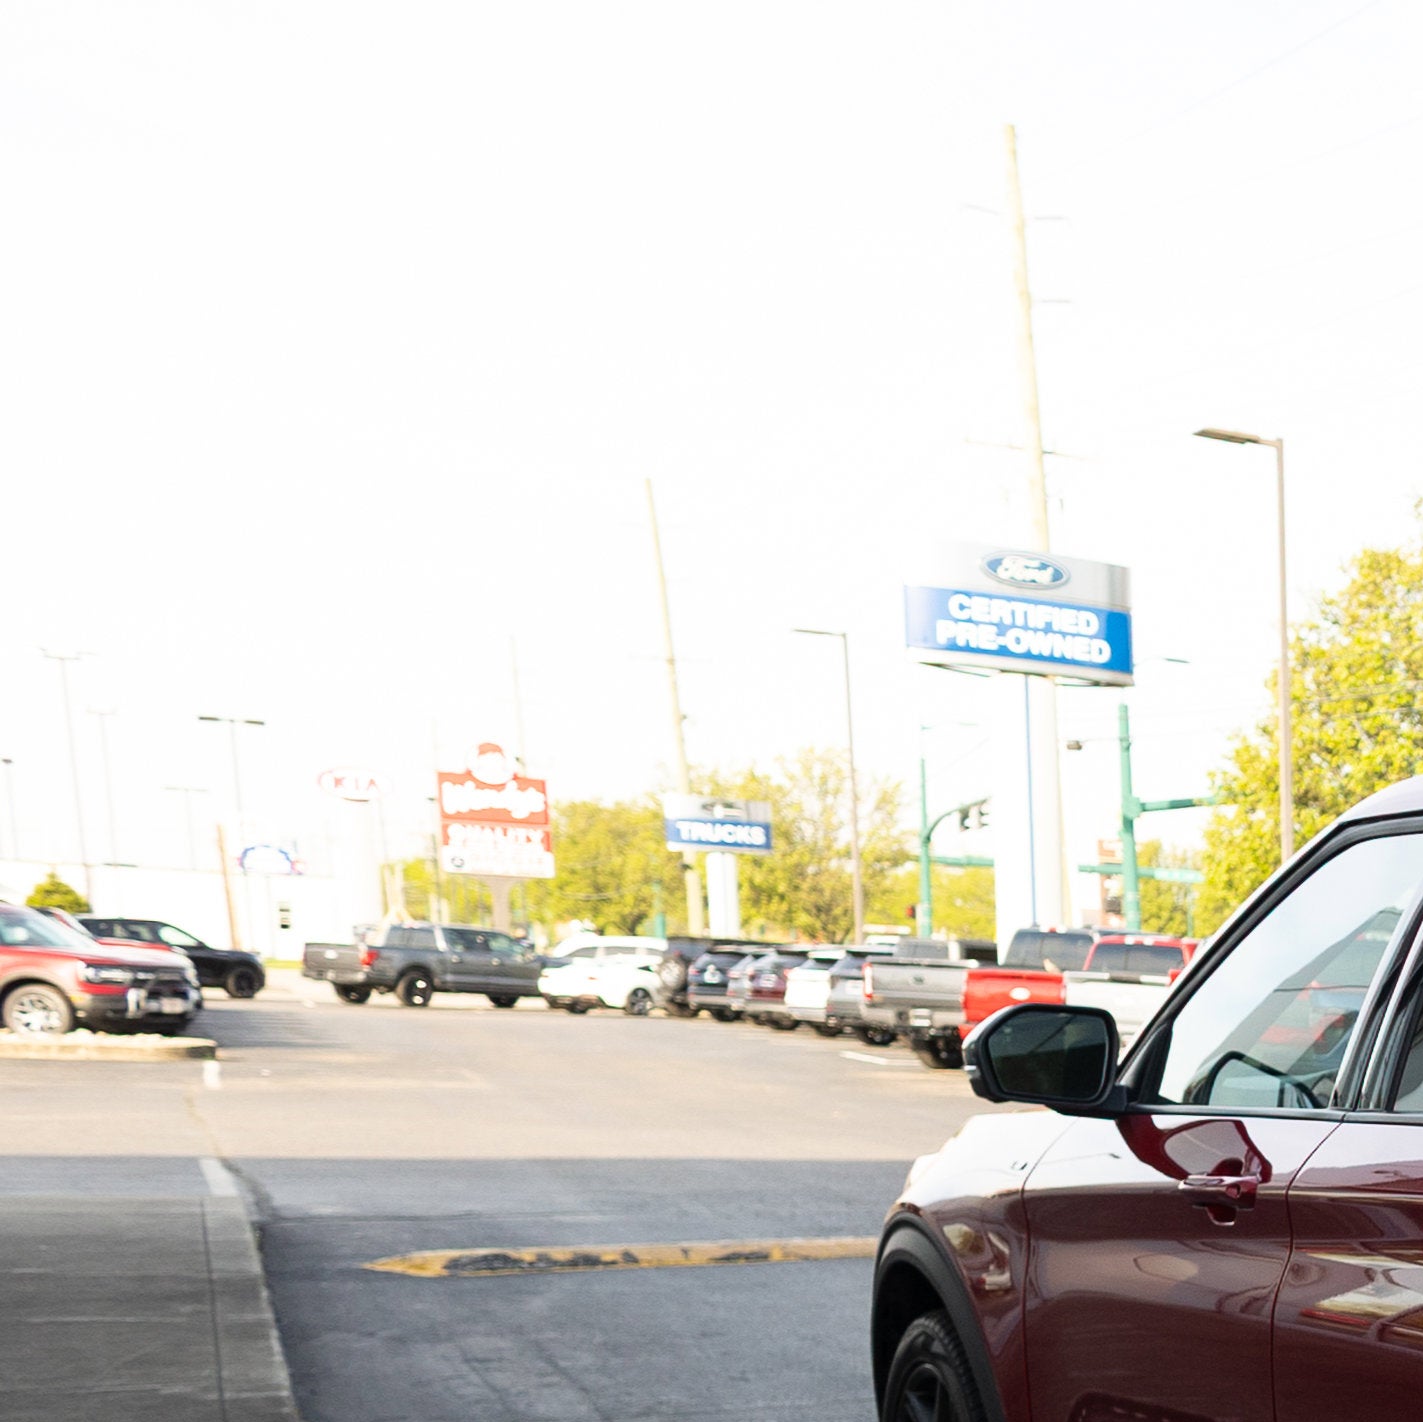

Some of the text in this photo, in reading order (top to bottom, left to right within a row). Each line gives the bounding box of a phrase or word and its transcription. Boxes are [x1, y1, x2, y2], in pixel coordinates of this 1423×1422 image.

[948, 593, 1099, 636] CERTIFIED
[935, 619, 1112, 664] PRE-OWNED
[333, 776, 381, 792] KIA
[675, 820, 767, 846] TRUCKS
